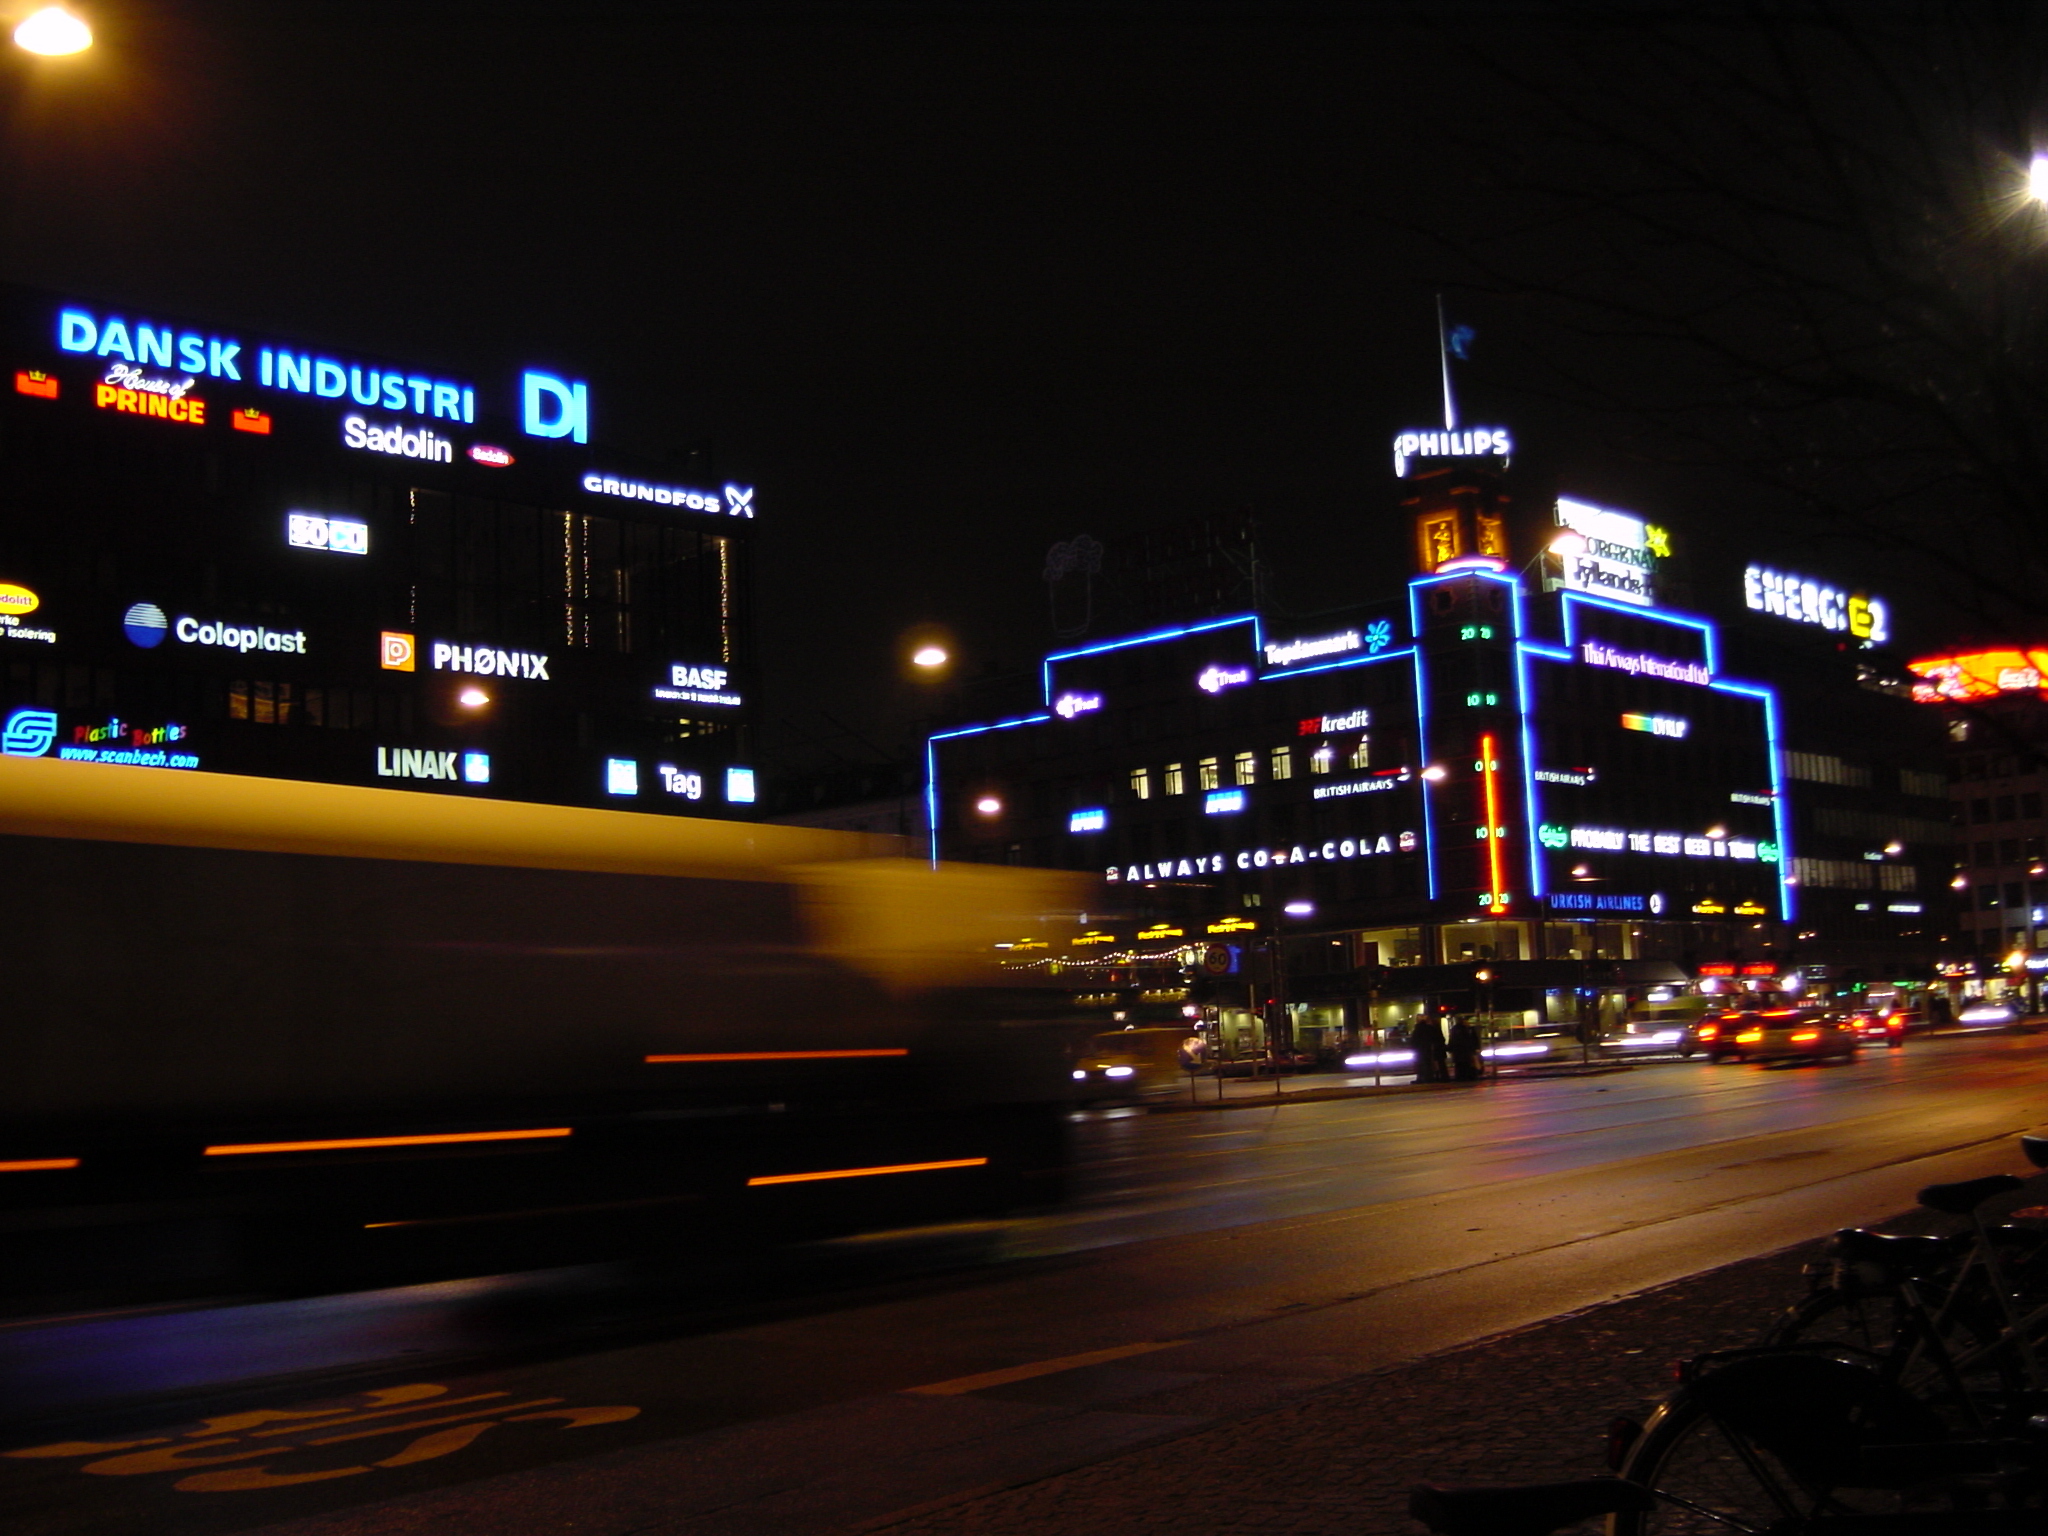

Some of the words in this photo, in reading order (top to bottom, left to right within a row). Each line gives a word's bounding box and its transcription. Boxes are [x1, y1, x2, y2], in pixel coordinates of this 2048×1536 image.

[60, 310, 242, 382] DANSK
[261, 349, 474, 424] INDUSTRI
[96, 384, 205, 424] PRINCE
[523, 371, 589, 446] DI
[343, 416, 453, 464] Sadolin
[1402, 431, 1510, 456] PHILIPS
[583, 475, 721, 514] GRUNDFOS
[1744, 567, 1847, 631] ENERGI
[7, 626, 57, 644] isolering
[176, 617, 307, 654] Coloplast
[433, 642, 550, 680] PHØNIX
[672, 665, 728, 691] BASF
[1583, 642, 1604, 665] Thai
[1604, 648, 1640, 675] Airways
[1640, 654, 1694, 682] International
[74, 717, 129, 745] Plastic
[132, 723, 188, 747] Bottles
[59, 747, 200, 769] www.scanbech.com
[377, 746, 458, 781] LINAK
[660, 766, 702, 800] Tag
[1314, 783, 1351, 800] BRITISH
[1127, 855, 1222, 882] ALWAYS
[1596, 894, 1643, 911] AIRLINES
[1209, 951, 1226, 966] 60
